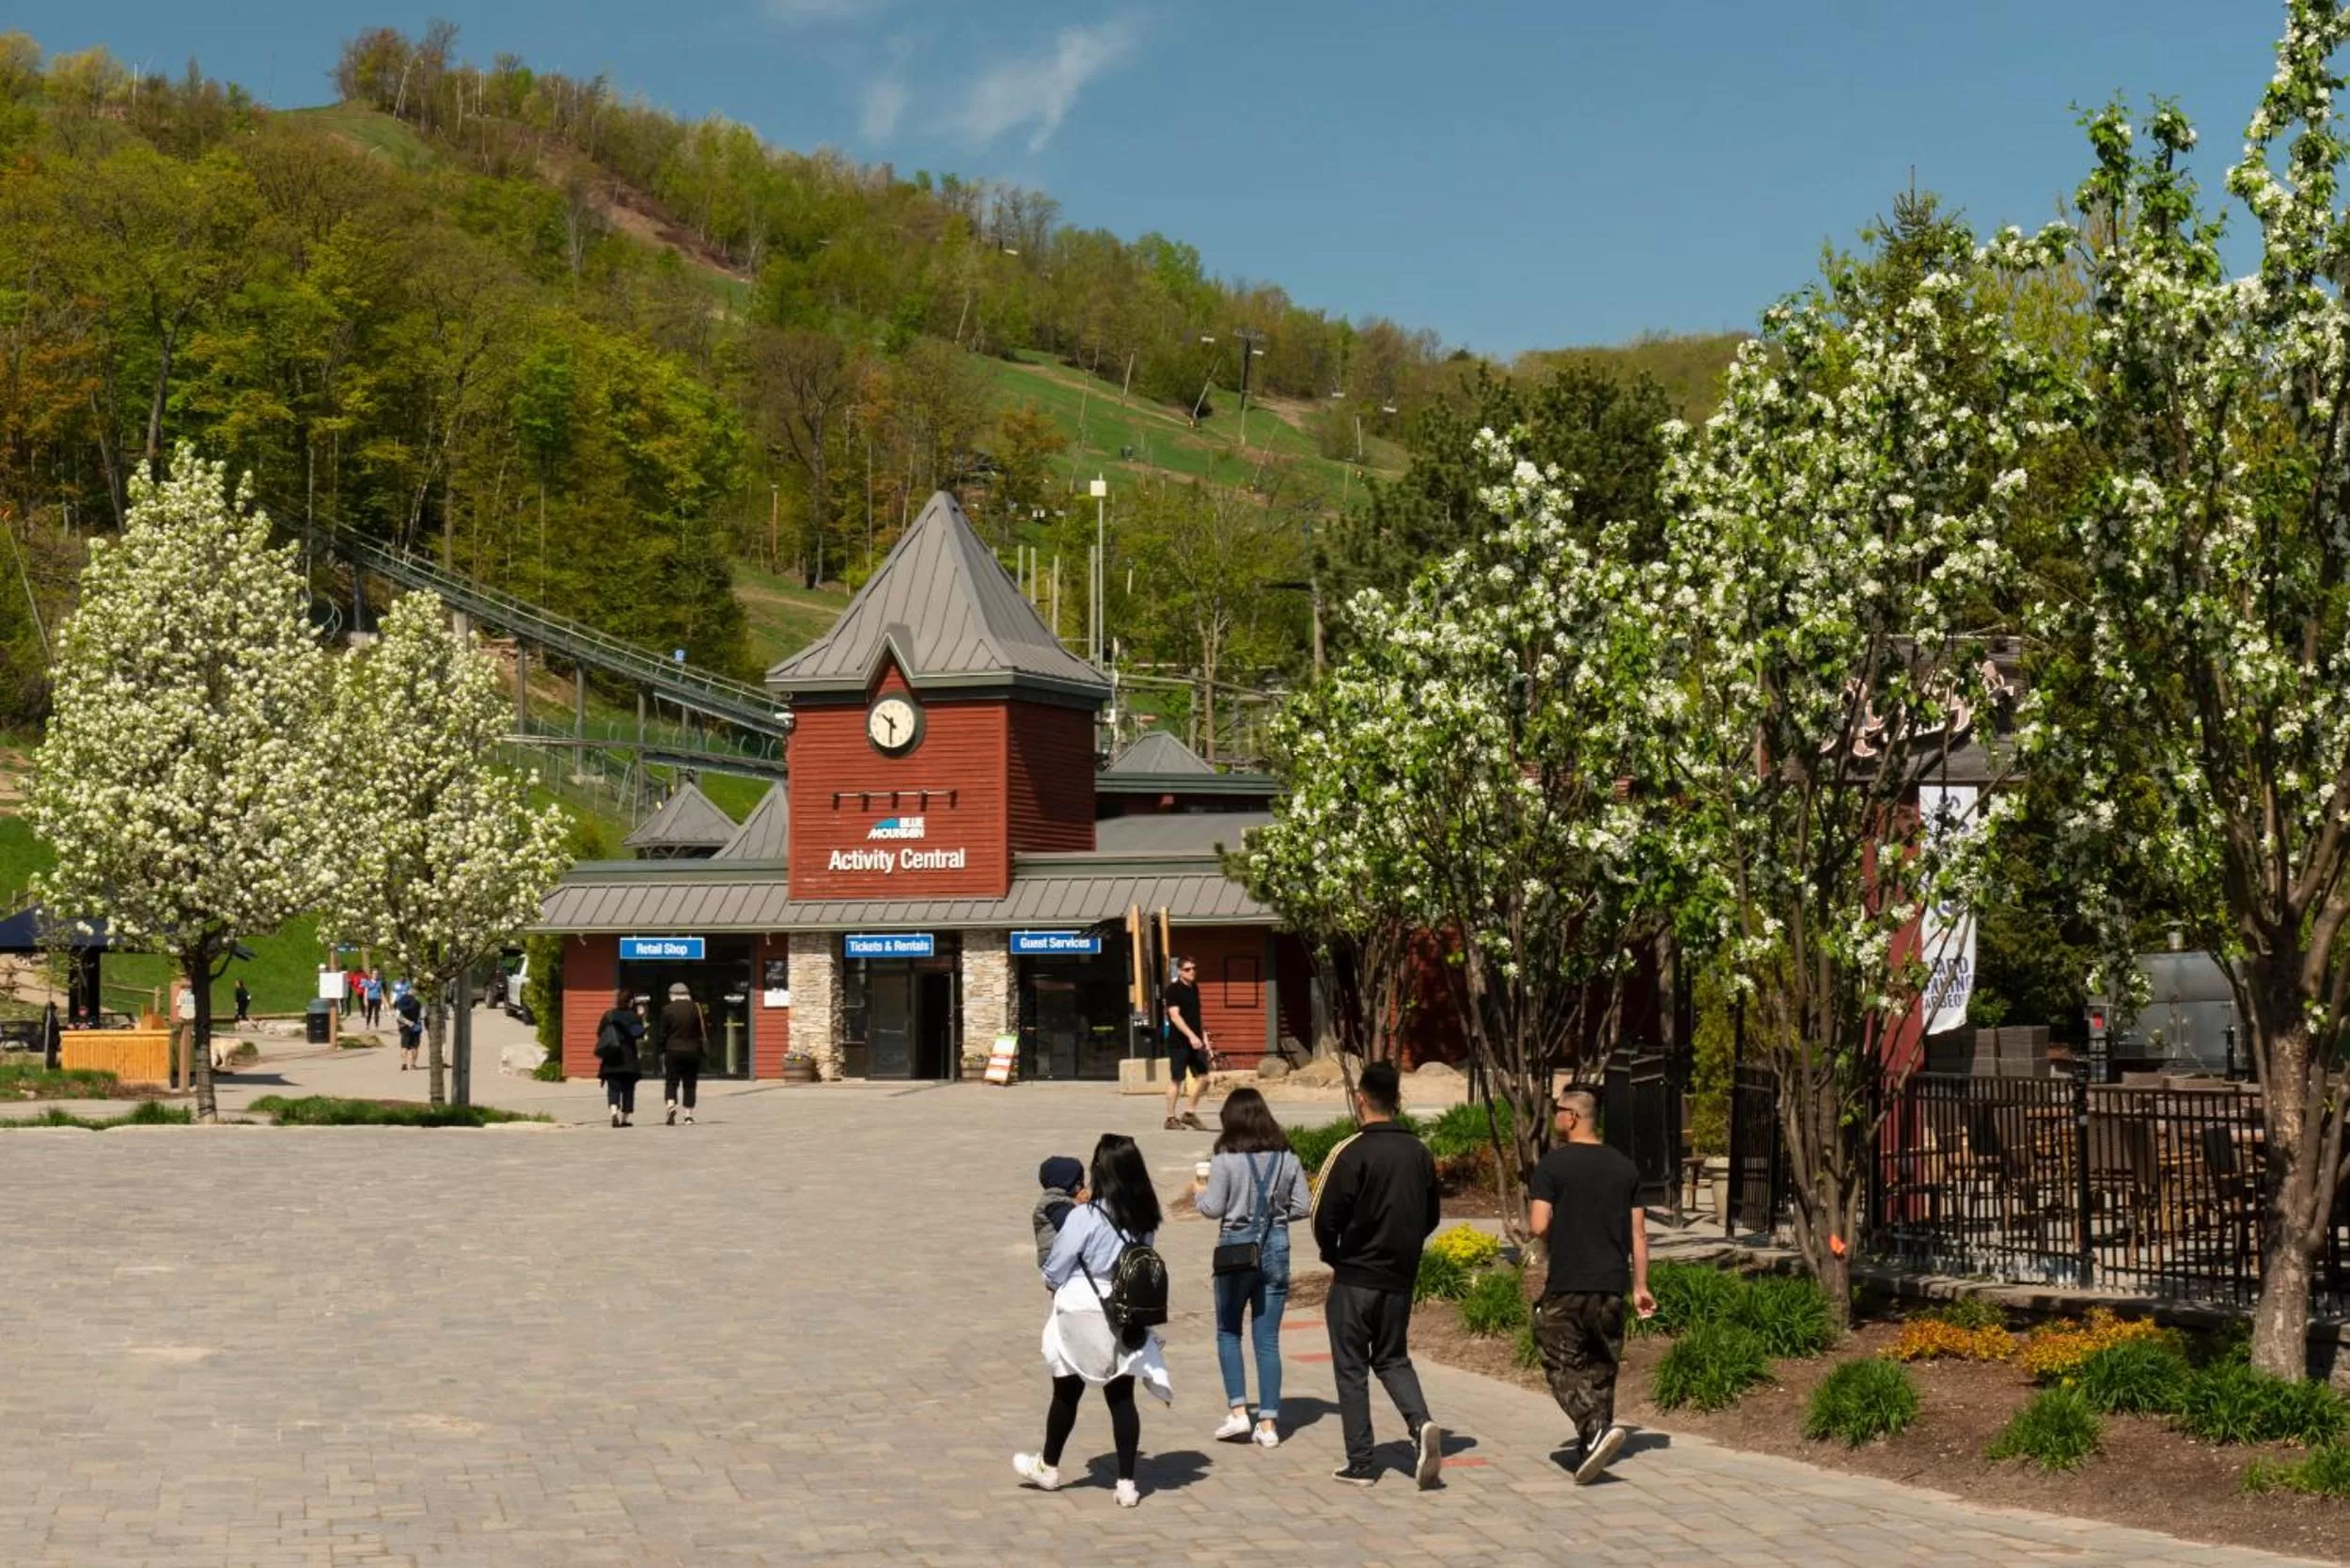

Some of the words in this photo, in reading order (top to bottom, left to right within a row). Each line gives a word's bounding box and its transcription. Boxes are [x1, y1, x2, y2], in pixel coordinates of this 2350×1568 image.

[828, 849, 895, 873] Activity
[901, 848, 965, 870] Central
[849, 941, 883, 952] Tickets
[885, 941, 892, 951] &
[894, 940, 930, 951] Rentals
[1020, 937, 1048, 949] Guest
[1049, 936, 1090, 949] Services
[635, 943, 662, 955] Retail
[664, 943, 688, 956] Shop
